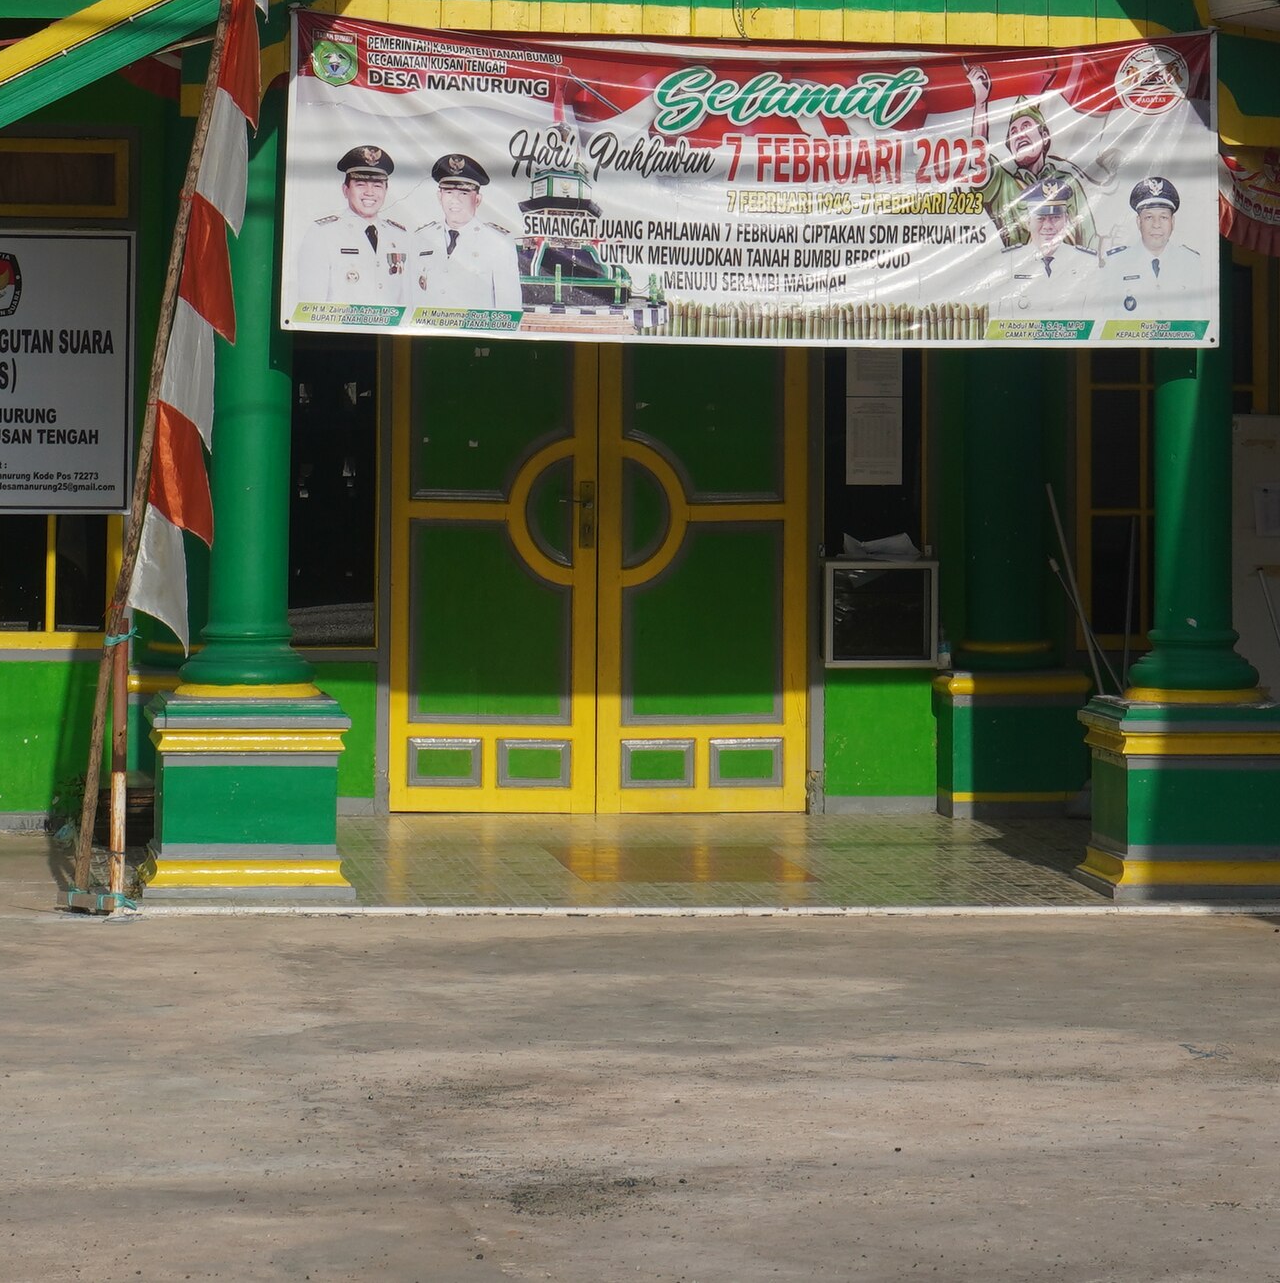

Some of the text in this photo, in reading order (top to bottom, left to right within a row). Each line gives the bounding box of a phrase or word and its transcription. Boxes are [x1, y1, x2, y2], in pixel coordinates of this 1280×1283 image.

[368, 37, 562, 64] PEMERINTAH KABUPATEN TANAH BUMBU
[368, 53, 506, 75] KECAMATAN KUSAN TENGAH
[369, 70, 548, 97] DESA MANURUNG
[656, 67, 926, 131] Selamat
[509, 129, 716, 182] Hari Pahlawan
[726, 136, 988, 186] 7 FEBRUARI 2023
[726, 191, 737, 212] 7
[739, 191, 813, 215] FEBRUARI
[861, 193, 871, 214] 7
[874, 192, 945, 215] FEBRUARI
[950, 192, 984, 215] 2023
[524, 215, 987, 245] SEMANGAT JUANG PAHLAWAN 7 FEBRUARI CIPTAKAN SDM BERKUALITAS
[600, 243, 910, 269] UNTUK MEWUJUDKAN TANAH BUMBU BERSUJUD
[663, 271, 847, 293] MENUJU SERAMBI MADINAH
[311, 314, 336, 322] BUPATI
[415, 318, 438, 326] WAKIL
[466, 320, 490, 328] TANAH
[492, 321, 518, 329] BUMBU
[59, 329, 114, 354] SUARA
[39, 429, 99, 445] TENGAH
[33, 472, 54, 480] Kode
[56, 472, 71, 480] Pos
[74, 472, 99, 480] 72273
